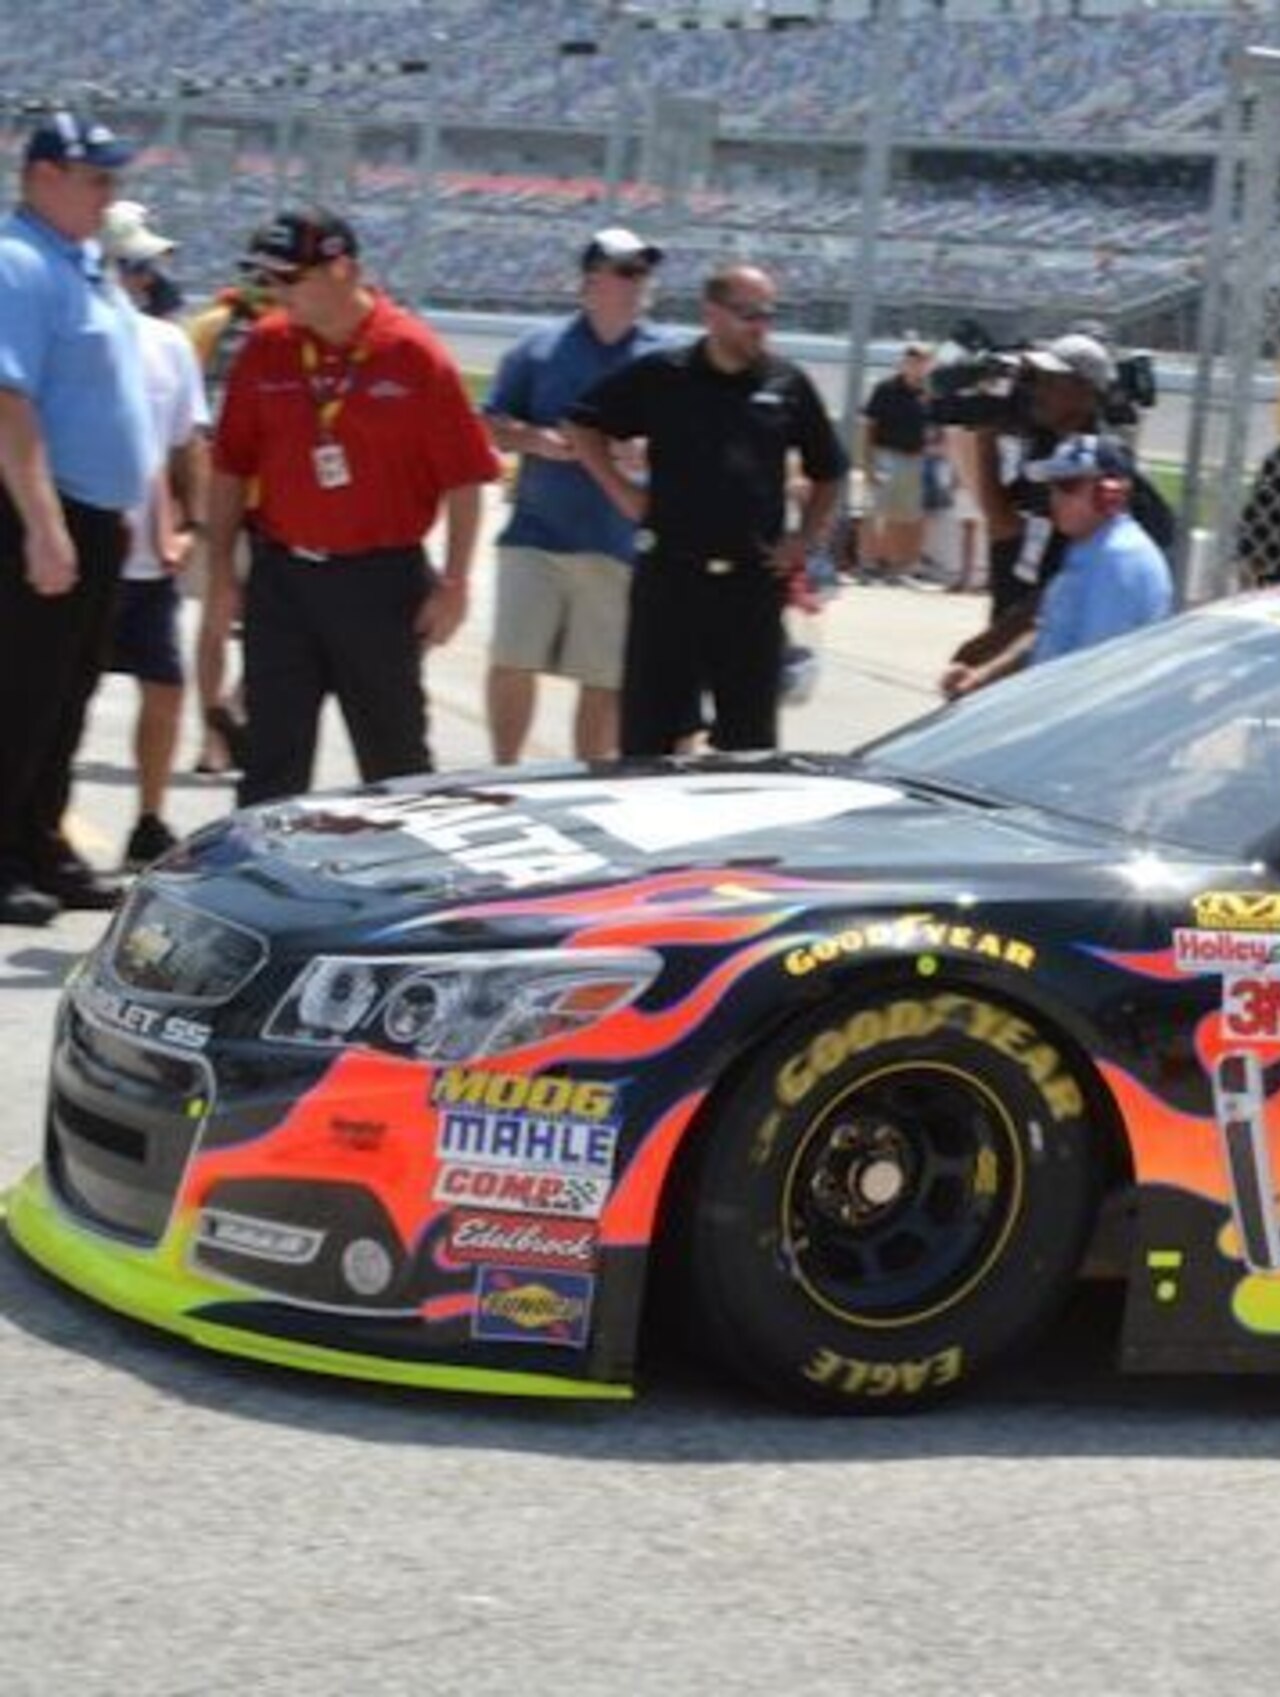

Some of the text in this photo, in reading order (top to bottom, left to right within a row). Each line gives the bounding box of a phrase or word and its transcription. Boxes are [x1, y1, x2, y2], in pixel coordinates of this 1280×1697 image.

[785, 914, 1036, 976] GOODYEAR
[1179, 934, 1266, 966] Holley
[159, 1016, 212, 1047] SS
[776, 994, 1083, 1121] GOODYEAR
[434, 1067, 614, 1119] MOOG
[443, 1113, 612, 1165] MAHLE
[444, 1167, 564, 1200] COMP
[452, 1217, 593, 1260] Edelbrock
[803, 1346, 966, 1394] EAGLE
